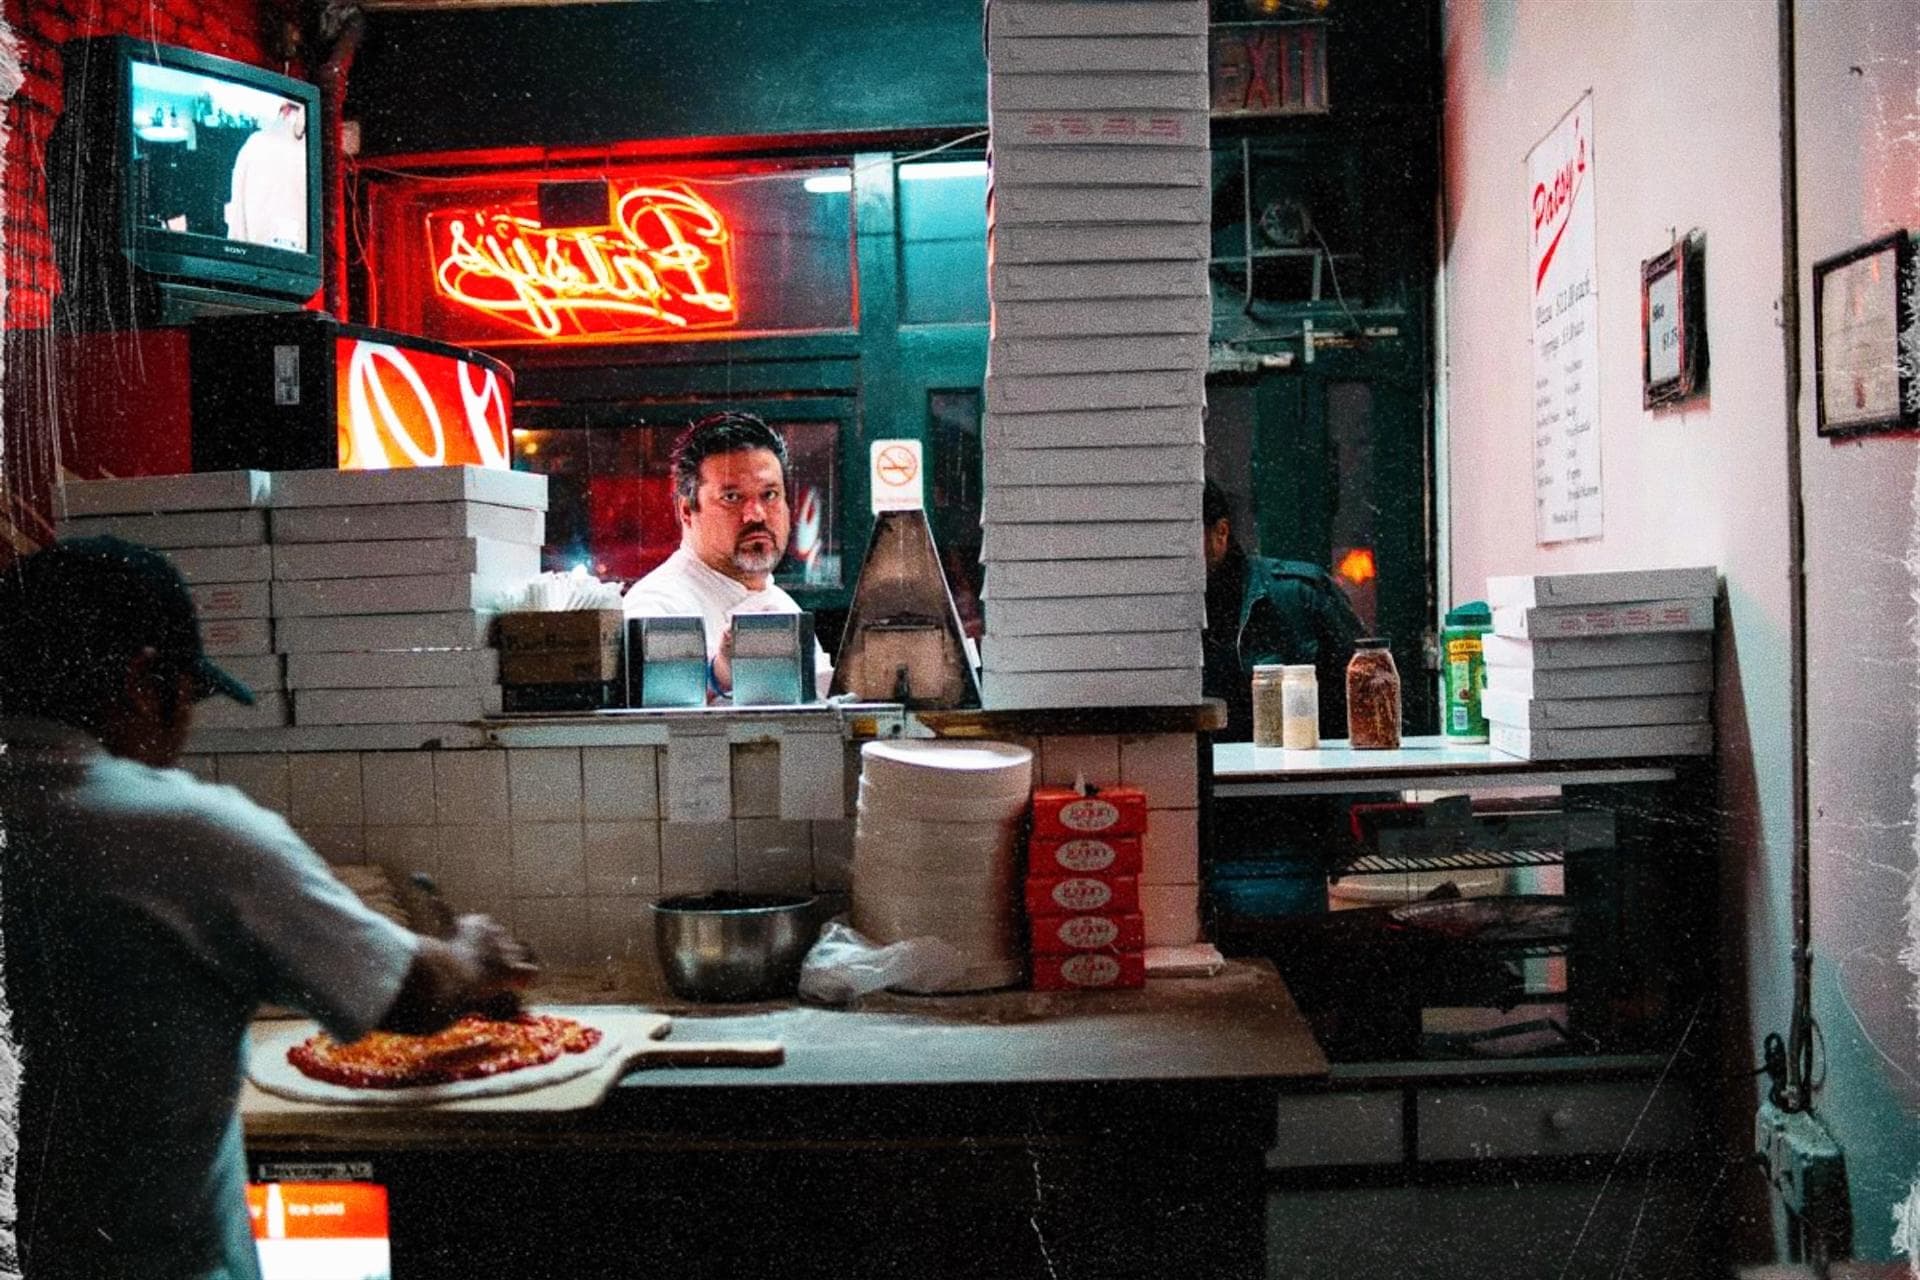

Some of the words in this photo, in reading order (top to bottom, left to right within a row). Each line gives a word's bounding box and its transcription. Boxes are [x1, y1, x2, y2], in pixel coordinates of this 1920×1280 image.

[1213, 30, 1320, 107] EXIT
[1533, 114, 1586, 252] Patsy's
[224, 246, 247, 255] SONY
